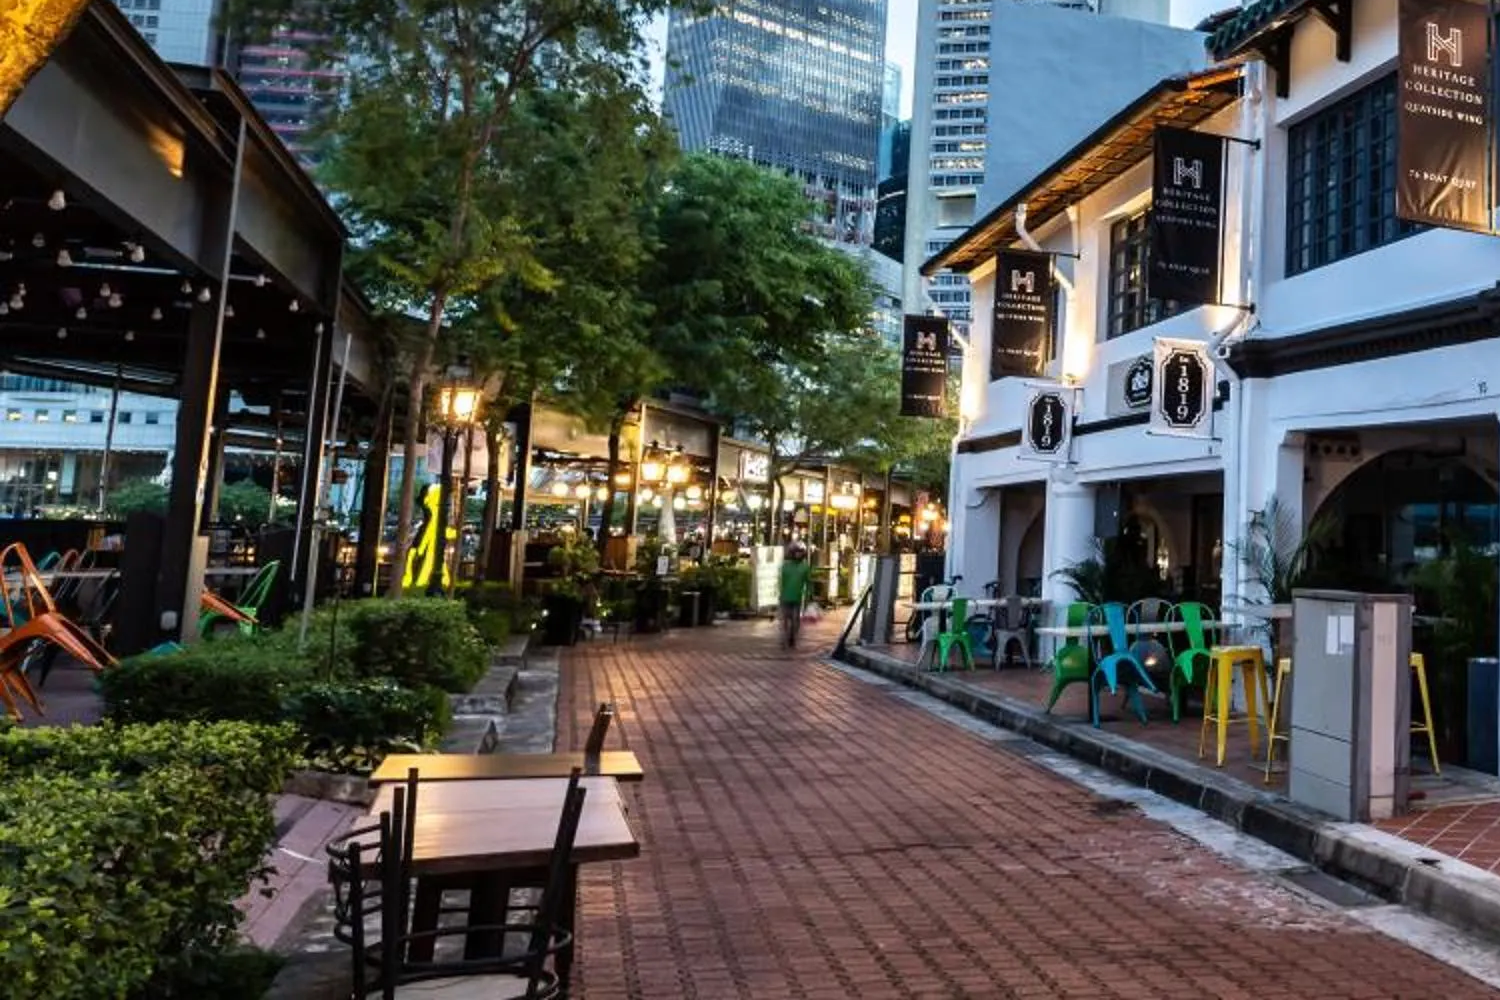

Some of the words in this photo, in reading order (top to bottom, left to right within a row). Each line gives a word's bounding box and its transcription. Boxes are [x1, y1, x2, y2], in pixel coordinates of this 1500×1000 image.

[1413, 64, 1475, 87] HERITAGE
[1405, 80, 1483, 105] COLLECTION
[1457, 112, 1483, 125] WING
[1177, 365, 1189, 420] 1819
[1041, 403, 1053, 447] 1819
